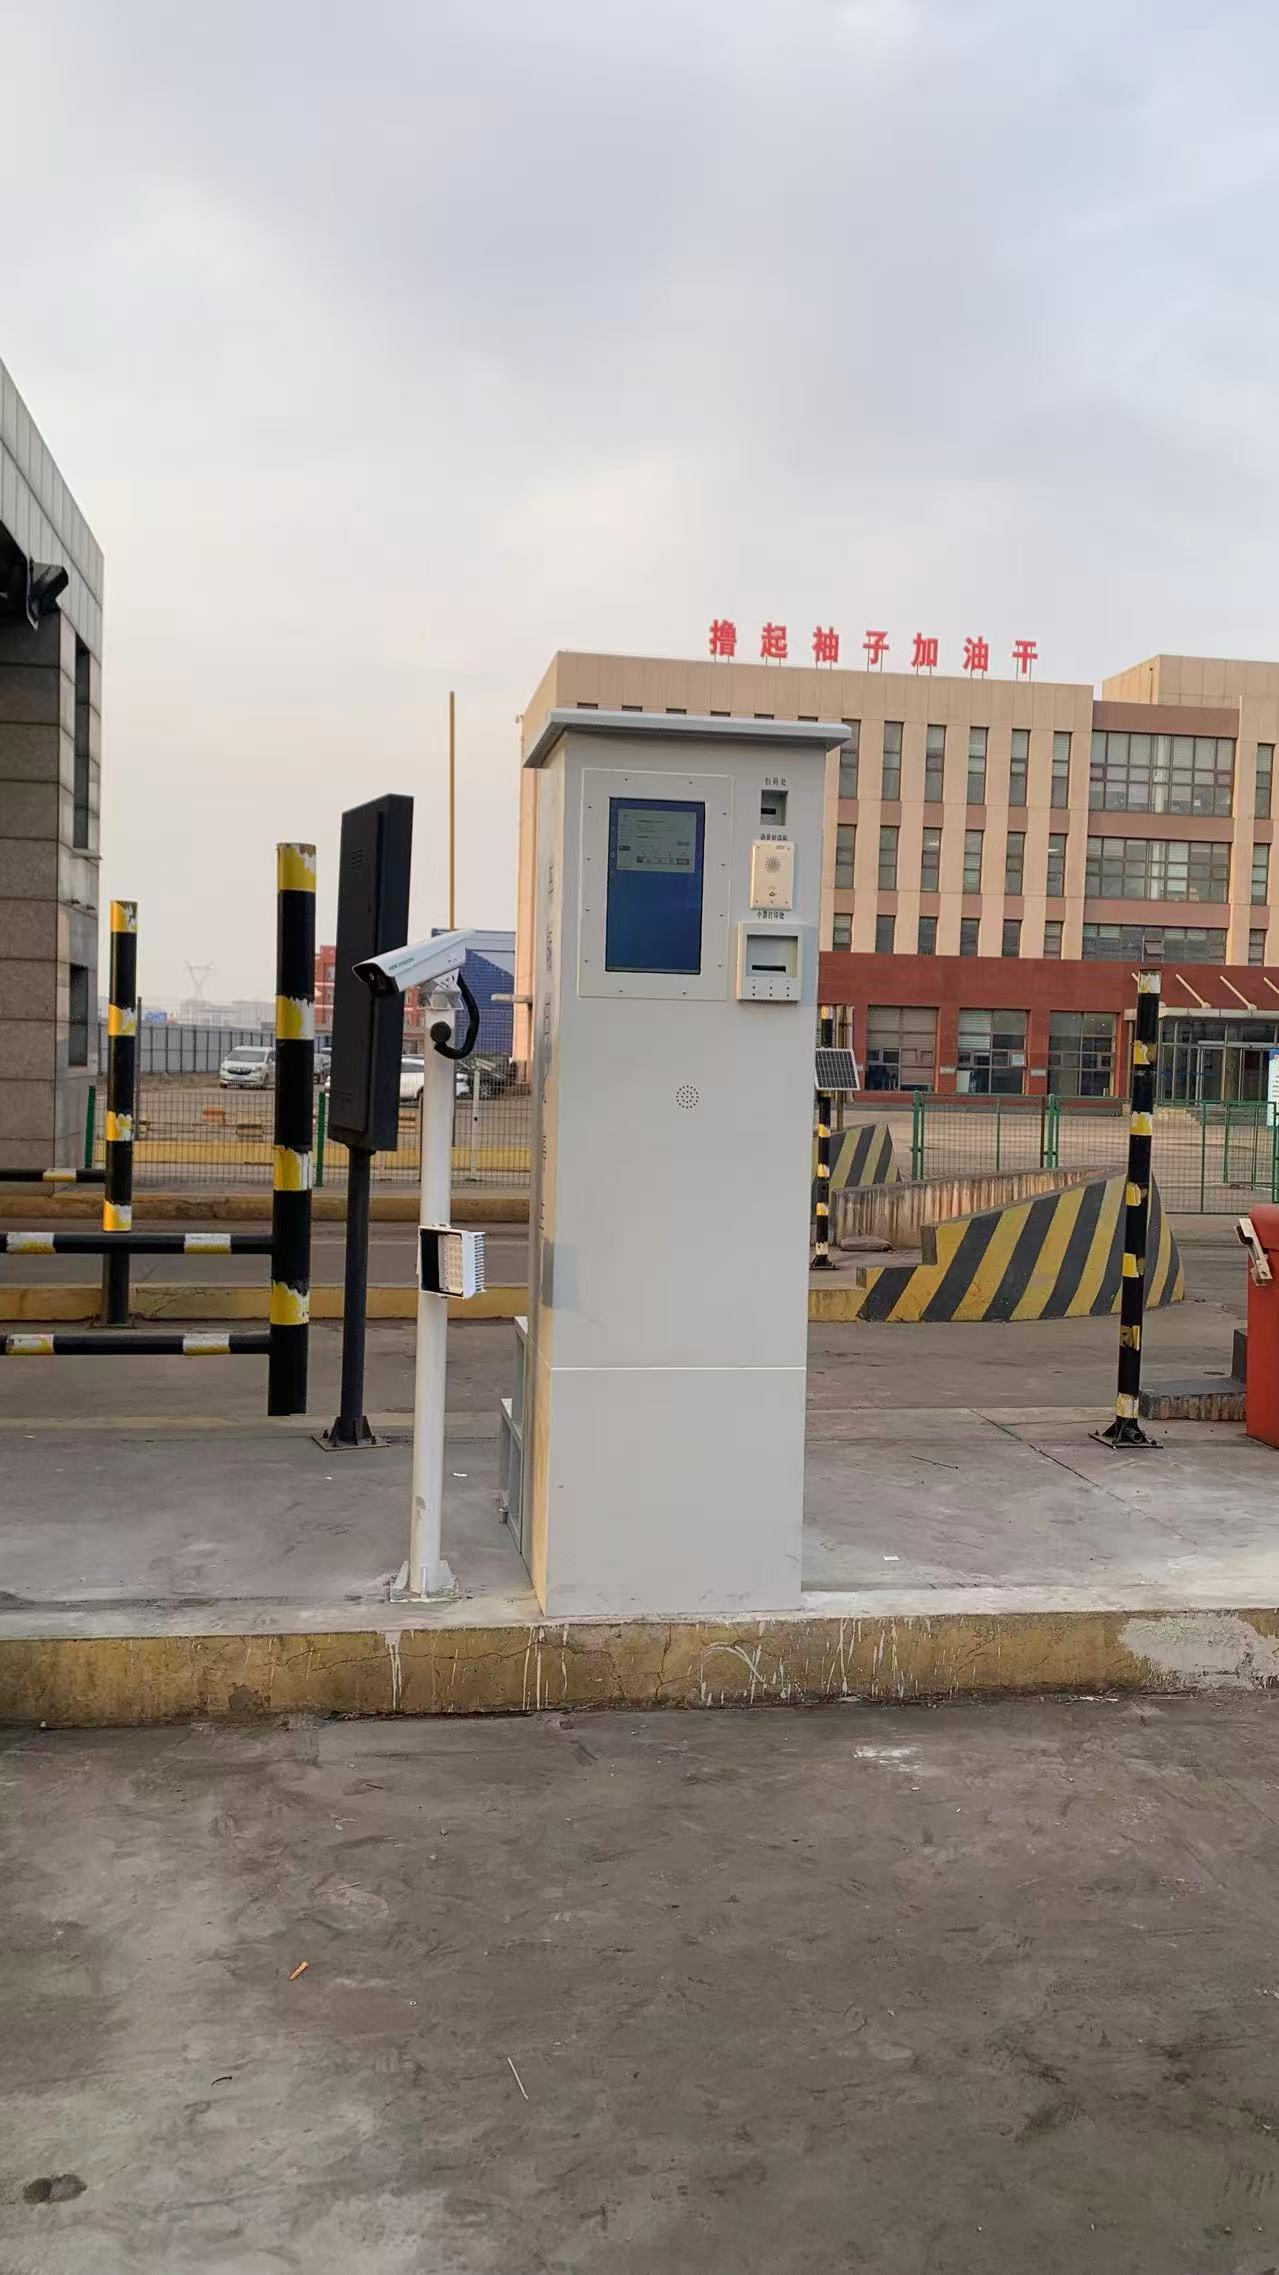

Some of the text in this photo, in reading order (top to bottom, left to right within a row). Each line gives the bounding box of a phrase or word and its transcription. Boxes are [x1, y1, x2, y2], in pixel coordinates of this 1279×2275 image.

[709, 619, 1038, 674] 撸起袖子加油干
